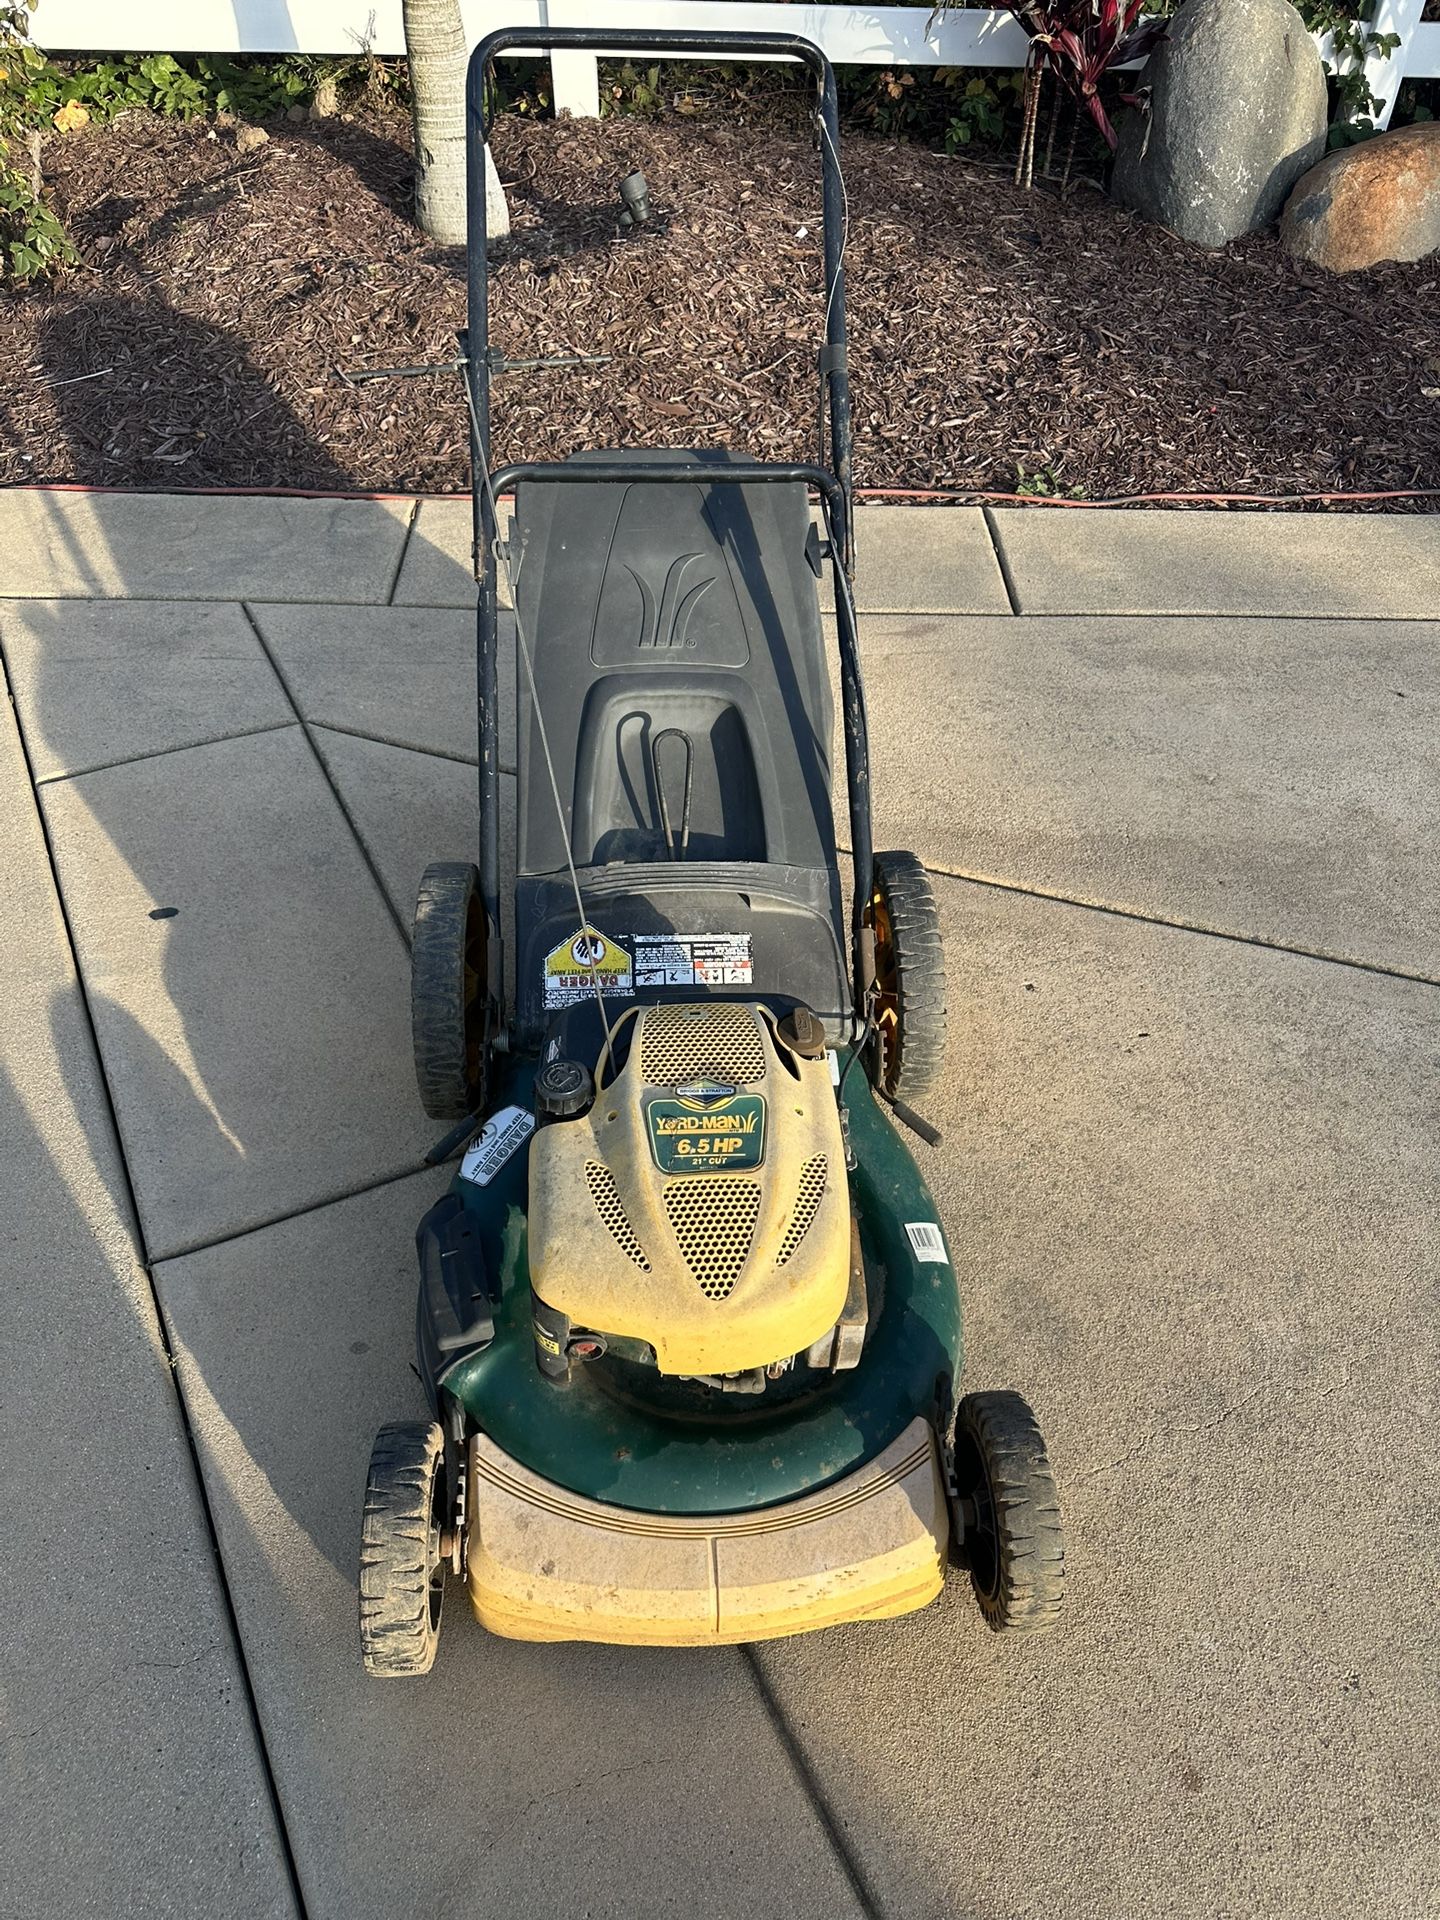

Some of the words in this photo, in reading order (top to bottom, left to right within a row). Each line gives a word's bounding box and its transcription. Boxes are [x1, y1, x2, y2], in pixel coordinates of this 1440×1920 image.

[512, 1113, 522, 1124] KEEP
[481, 1121, 531, 1176] DANGER
[677, 1138, 710, 1155] 6.5
[712, 1137, 743, 1153] HP
[482, 1148, 493, 1160] FEET
[471, 1160, 483, 1175] AWAY
[708, 1157, 728, 1165] CUT
